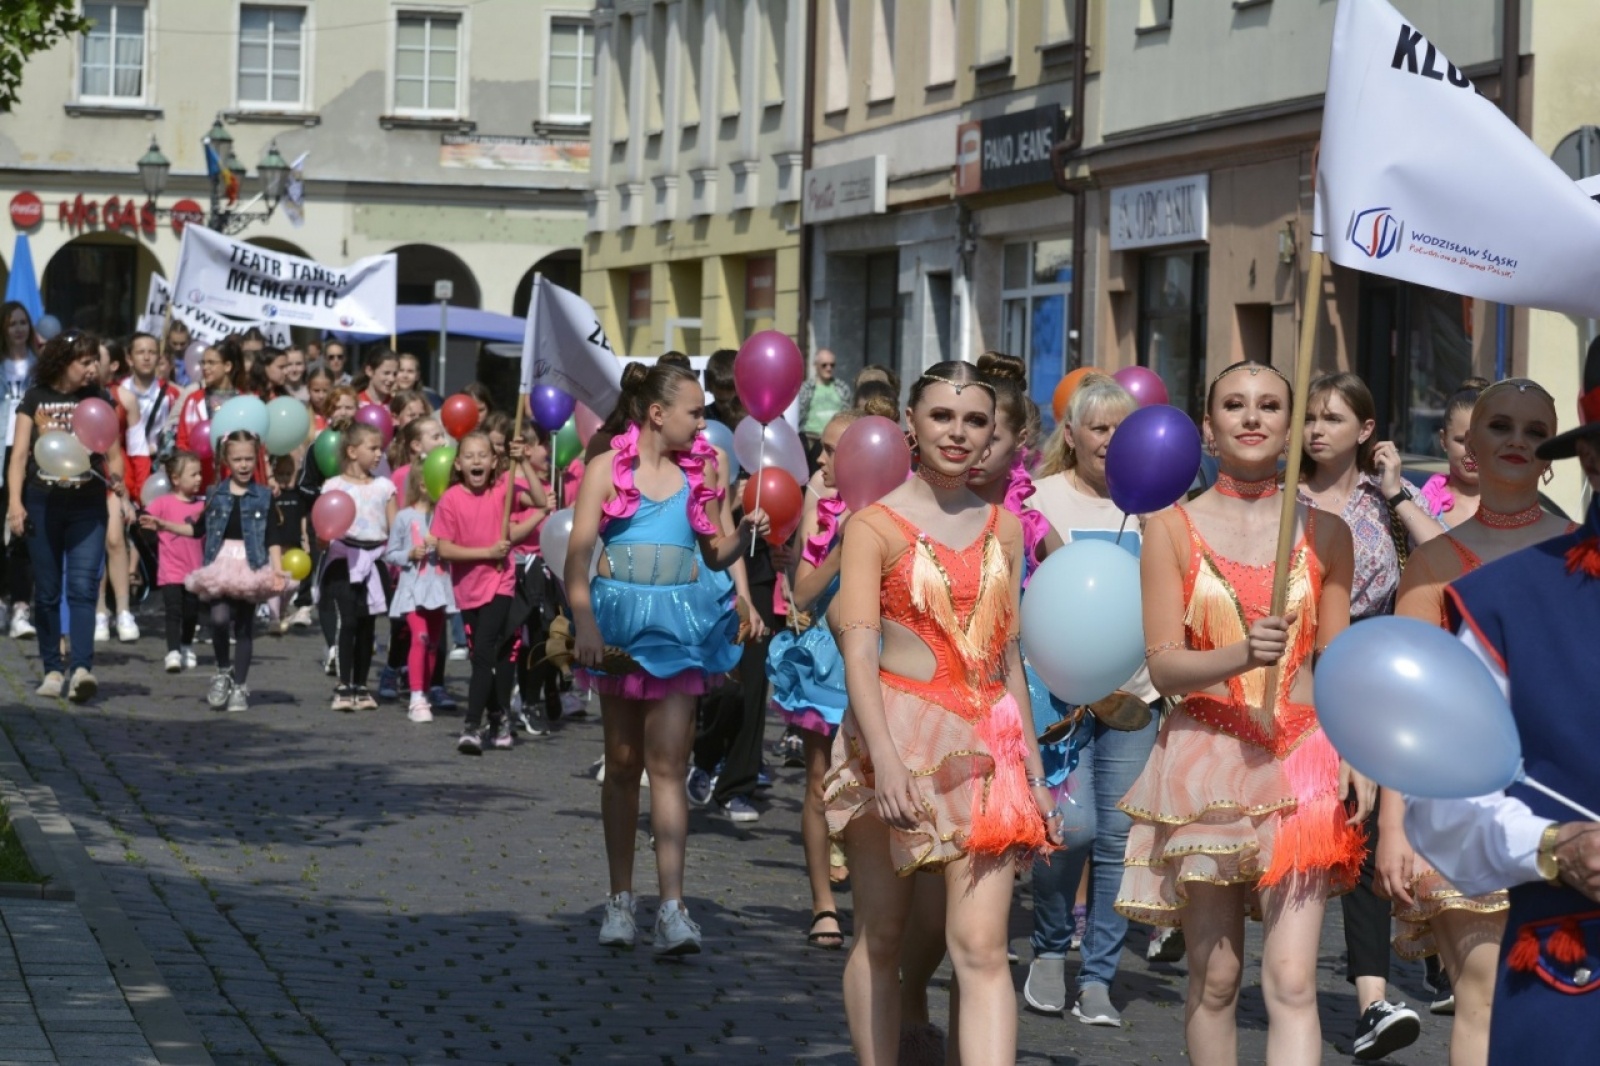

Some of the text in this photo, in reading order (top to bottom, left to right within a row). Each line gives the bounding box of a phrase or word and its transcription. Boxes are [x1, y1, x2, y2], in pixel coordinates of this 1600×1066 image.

[1015, 126, 1052, 165] JEANS
[229, 244, 281, 277] TEATR
[1411, 230, 1518, 268] WODZISŁAW ŚLĄSKI
[226, 267, 338, 309] MEMENTO
